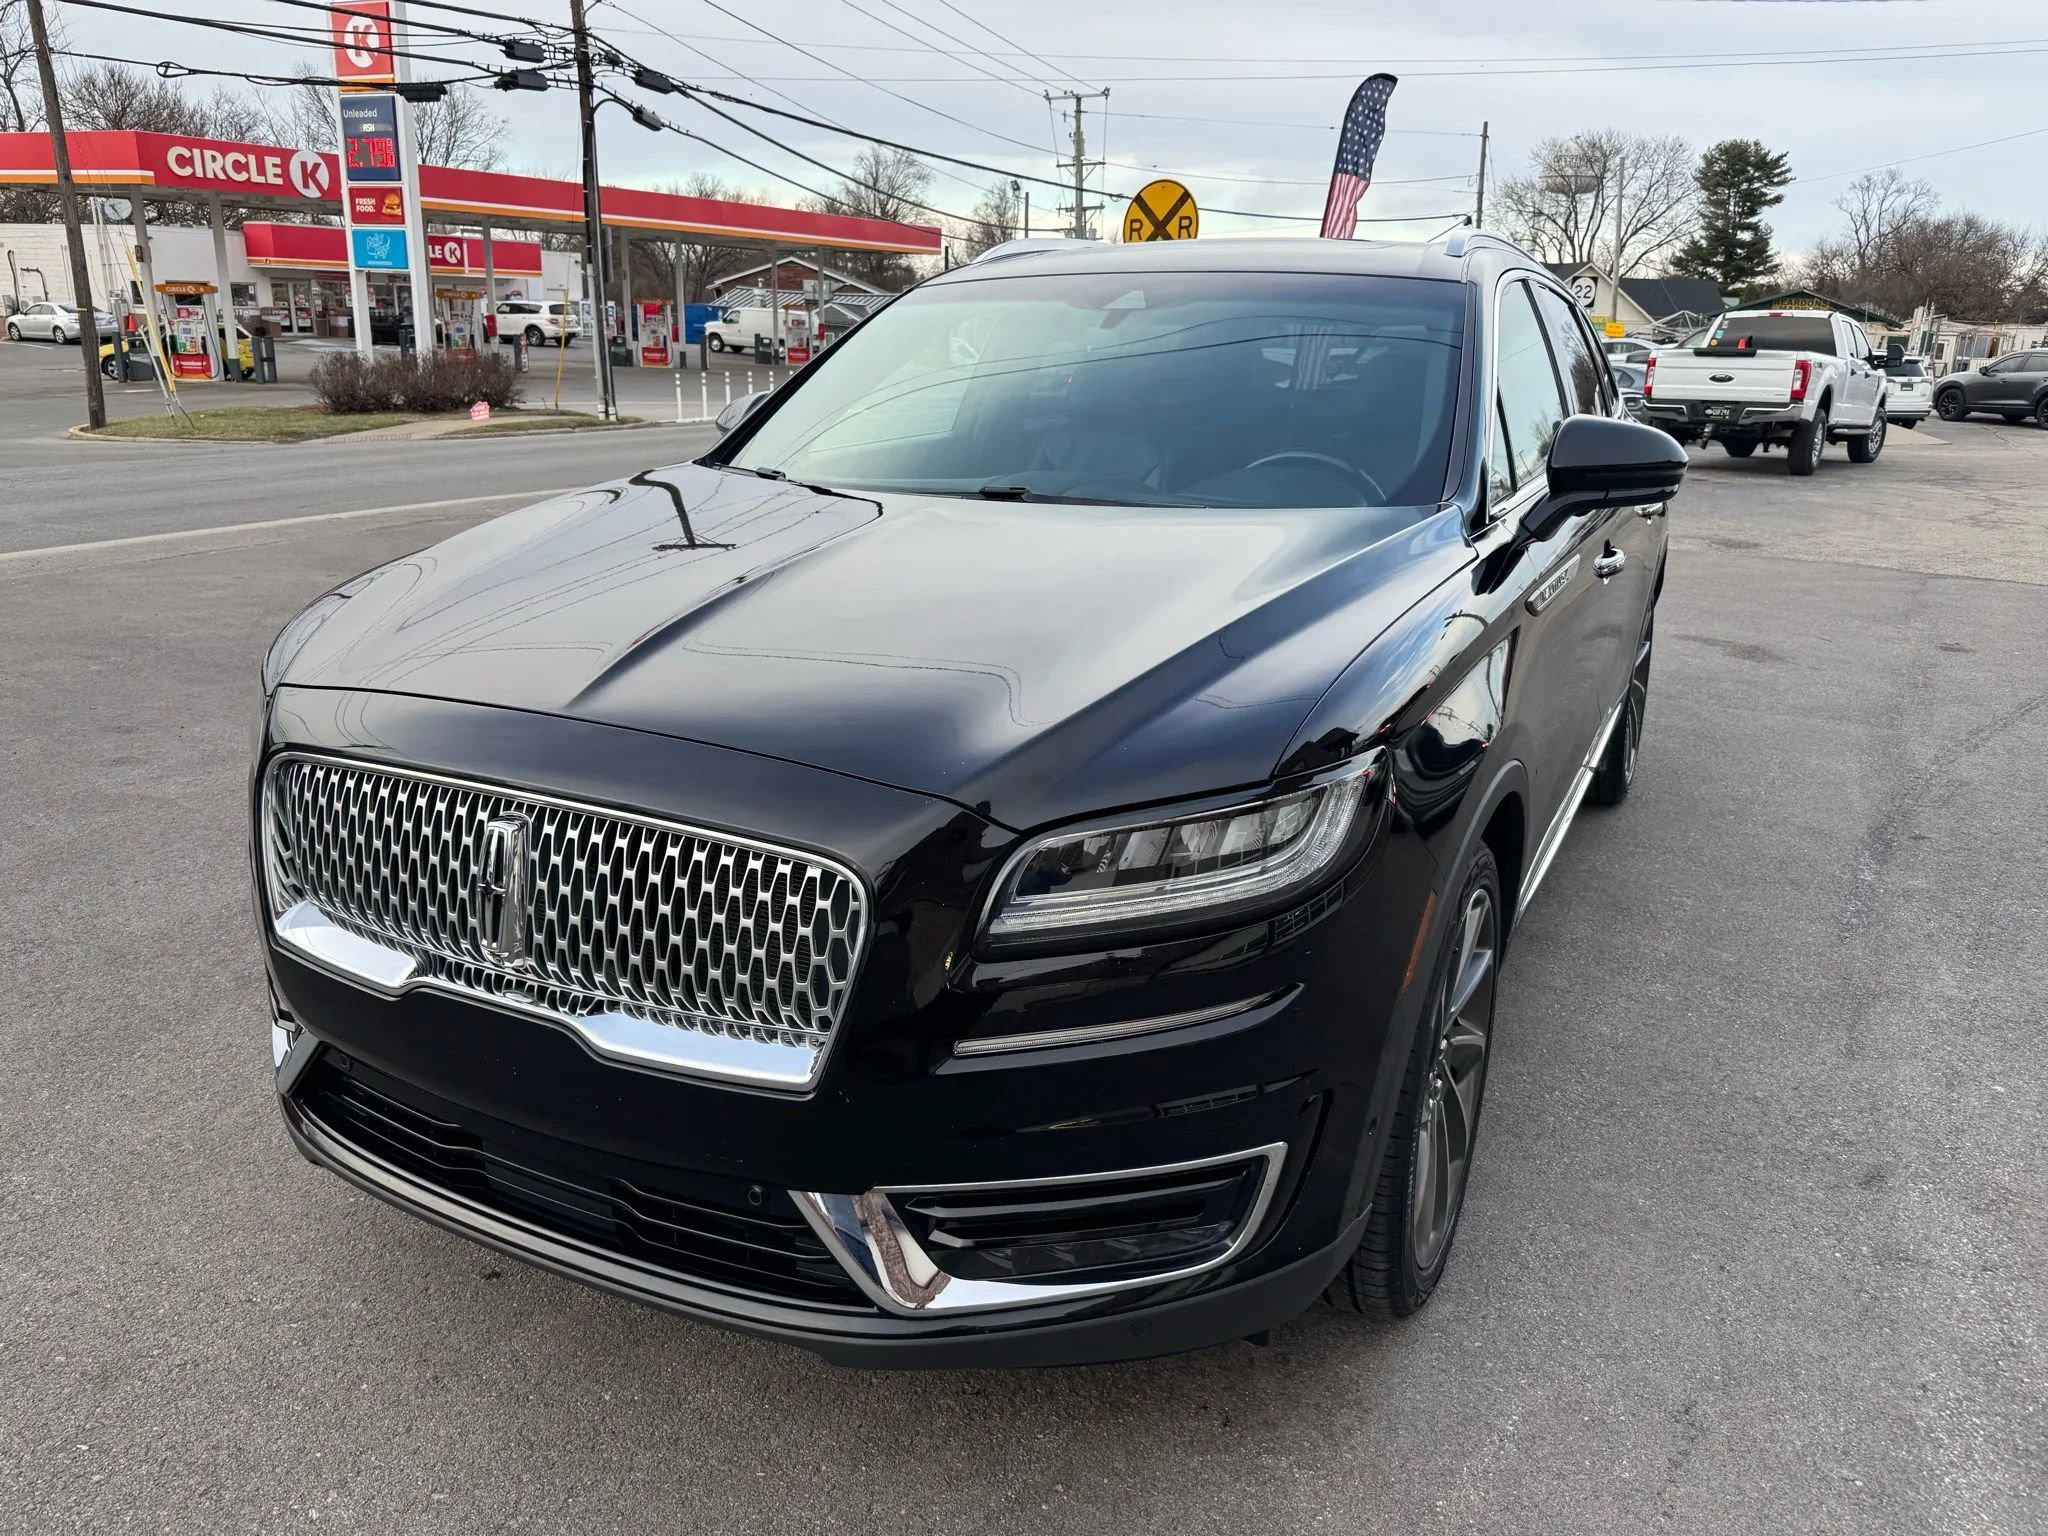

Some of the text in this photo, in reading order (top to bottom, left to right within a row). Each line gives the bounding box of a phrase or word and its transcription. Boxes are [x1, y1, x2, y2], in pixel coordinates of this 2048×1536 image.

[343, 108, 377, 118] Unleaded
[167, 146, 284, 185] CIRCLE
[356, 205, 376, 213] FOOD.
[1129, 215, 1192, 241] R R
[1575, 284, 1592, 299] 22
